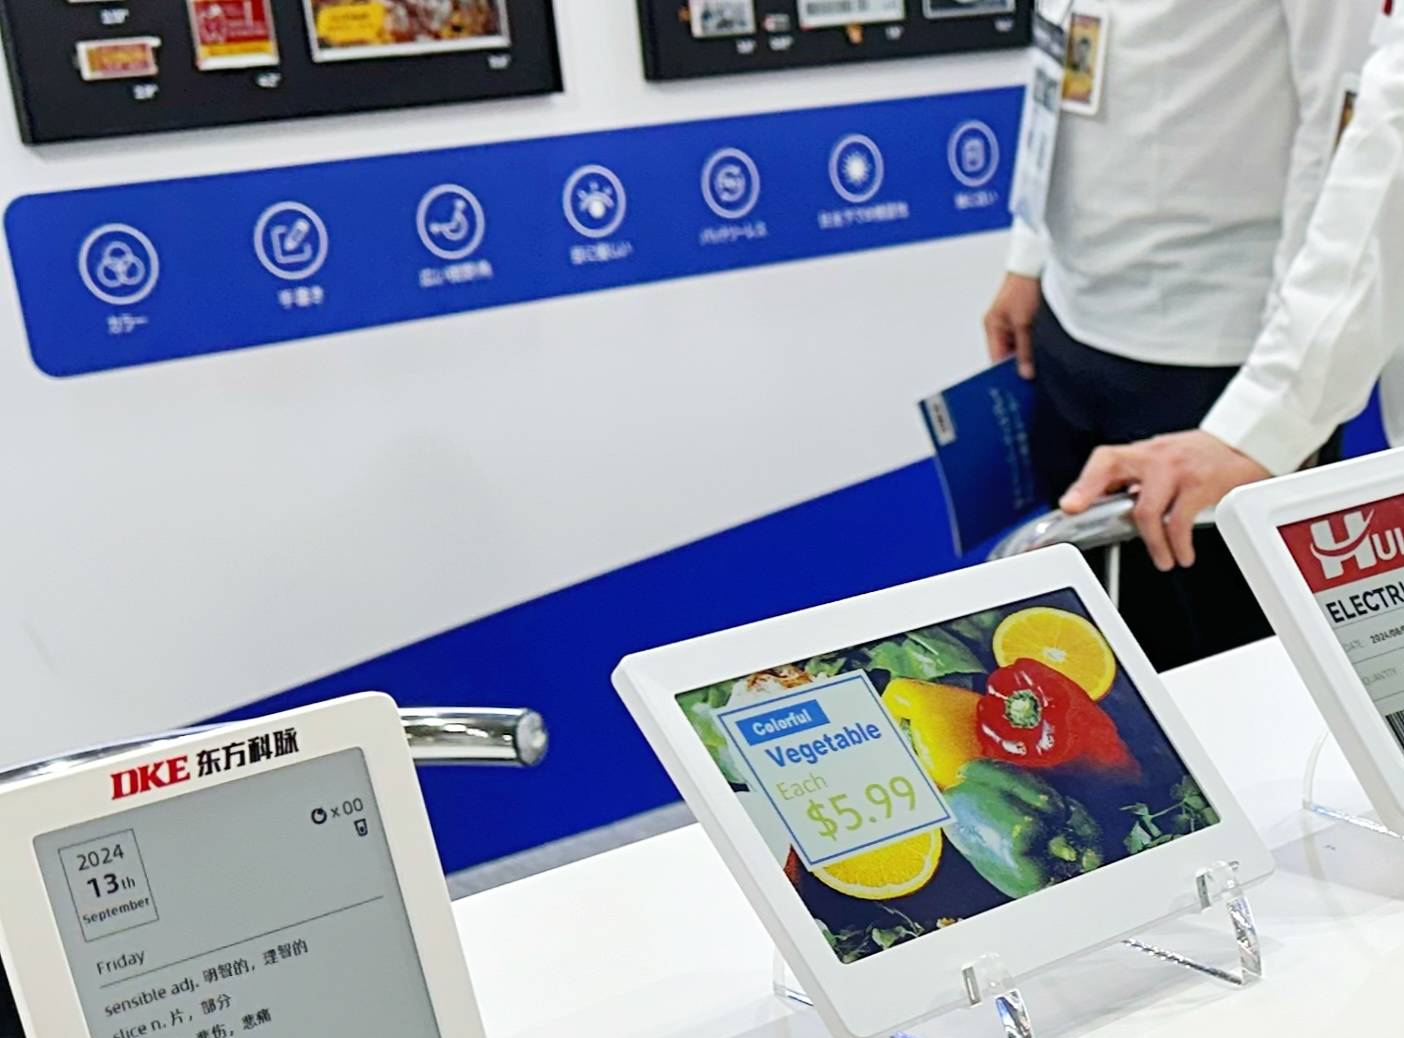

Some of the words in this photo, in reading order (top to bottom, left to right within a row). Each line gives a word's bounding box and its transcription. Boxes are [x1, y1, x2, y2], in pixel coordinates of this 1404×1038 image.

[752, 709, 812, 736] Colorful
[197, 727, 299, 778] 东方科脉
[765, 722, 882, 768] Vegetable
[110, 755, 191, 800] DKE
[776, 773, 829, 801] Each
[806, 776, 916, 841] $5.99
[76, 844, 124, 871] 2024
[87, 873, 136, 898] 13th
[82, 897, 150, 924] September
[96, 951, 145, 975] Friday
[104, 987, 167, 1018] sensible
[171, 977, 200, 995] adj.
[151, 1018, 167, 1032] n.
